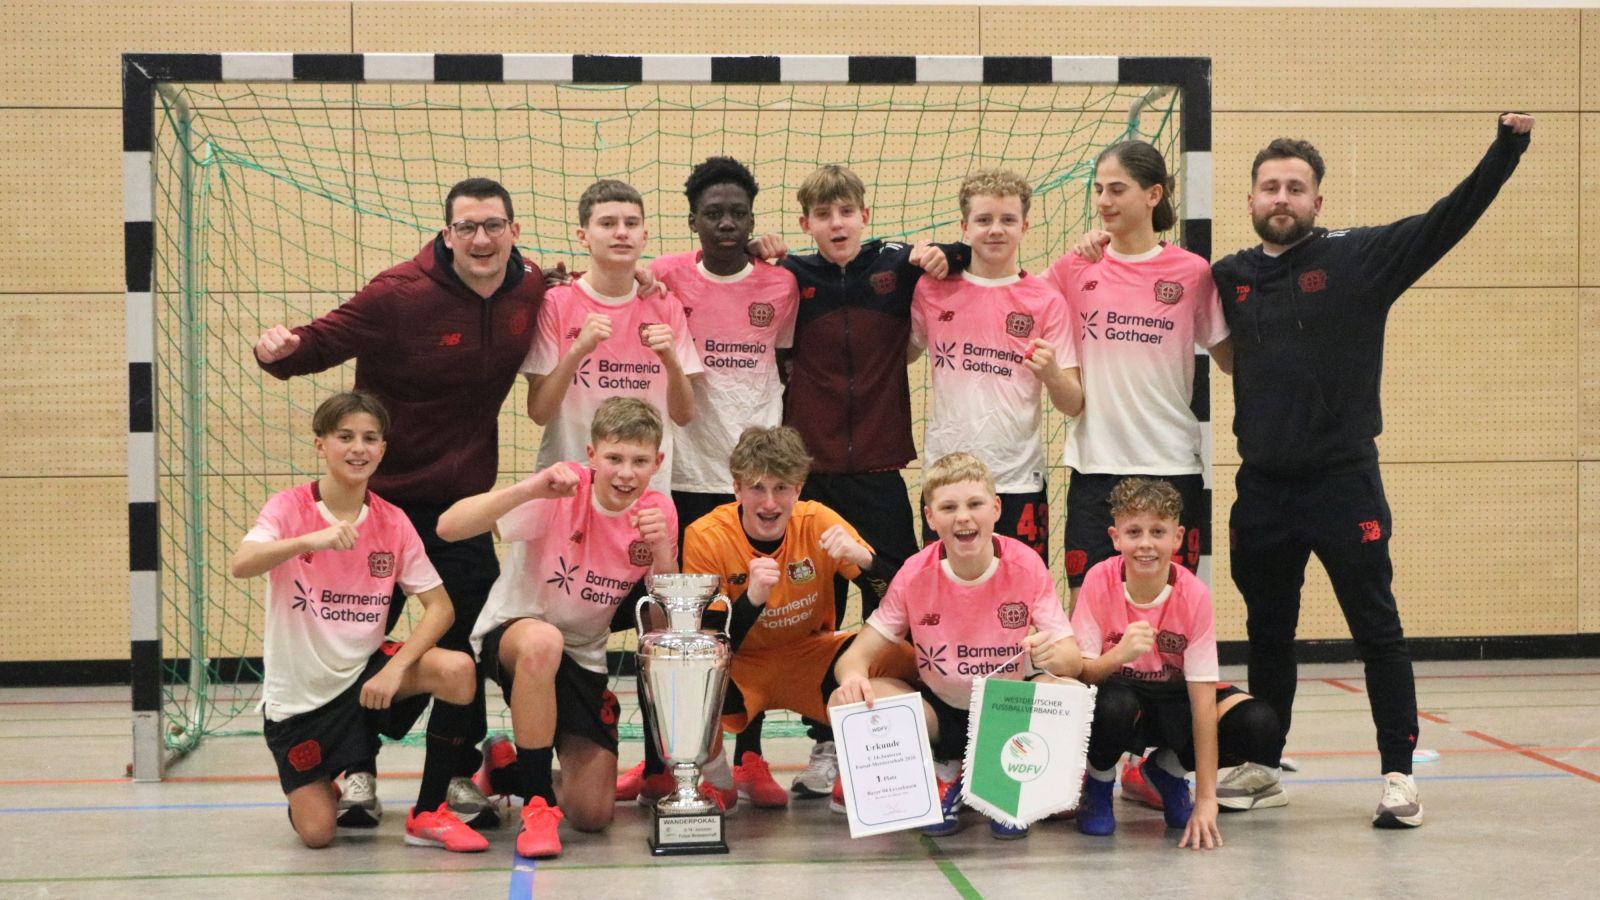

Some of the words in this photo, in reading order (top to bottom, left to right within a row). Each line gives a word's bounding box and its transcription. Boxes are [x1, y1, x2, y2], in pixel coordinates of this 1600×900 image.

[1107, 311, 1174, 331] Barmenia
[1105, 328, 1163, 344] Gothaer
[705, 340, 767, 354] Barmenia
[963, 343, 1024, 364] Barmenia
[599, 360, 660, 374] Barmenia
[704, 355, 758, 368] Gothaer
[962, 359, 1013, 377] Gothaer
[598, 376, 651, 389] Gothaer
[585, 570, 636, 591] Barmen
[321, 589, 391, 606] Barmenia
[581, 587, 623, 605] Gotha
[320, 607, 381, 623] Gothaer
[957, 662, 1020, 676] Gothaer
[1004, 696, 1062, 707] WESTDEUTSCHER
[992, 703, 1058, 716] FUSSBALLVERBAND
[865, 740, 900, 752] Urkunde
[1008, 763, 1042, 774] WDFV
